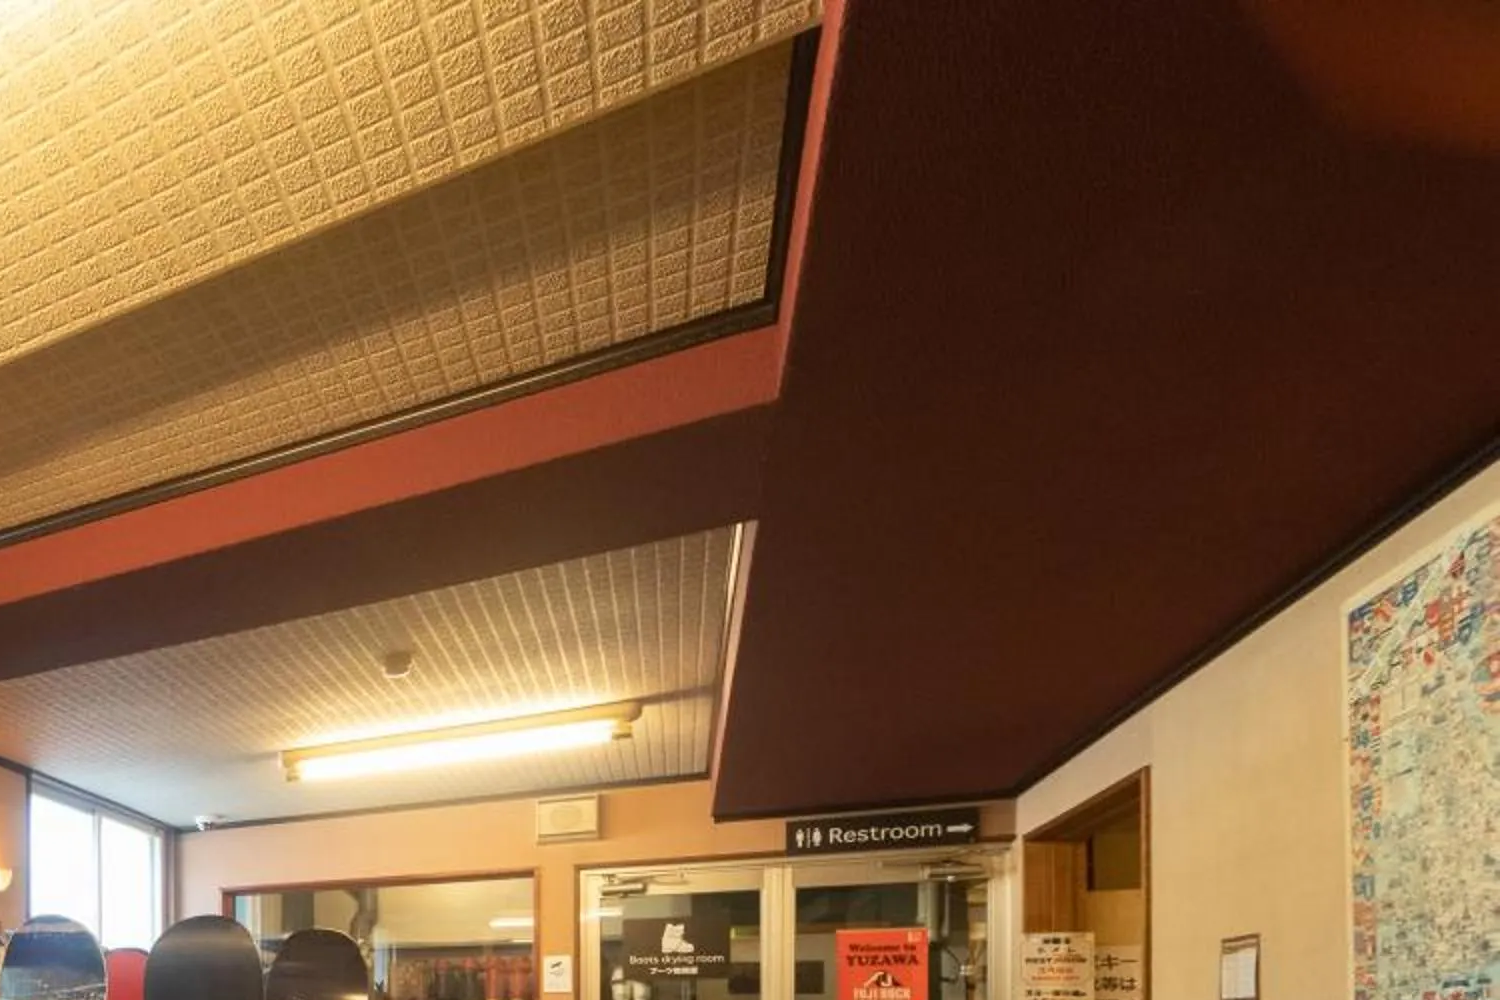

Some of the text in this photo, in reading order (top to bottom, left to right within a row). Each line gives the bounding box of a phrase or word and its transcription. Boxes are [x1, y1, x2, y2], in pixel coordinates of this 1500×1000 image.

[829, 823, 942, 844] Restroom
[848, 943, 900, 952] Welcome
[629, 955, 725, 965] Boots drying room
[846, 954, 919, 967] YUZAWA
[853, 987, 911, 1000] FUJI ROCK
